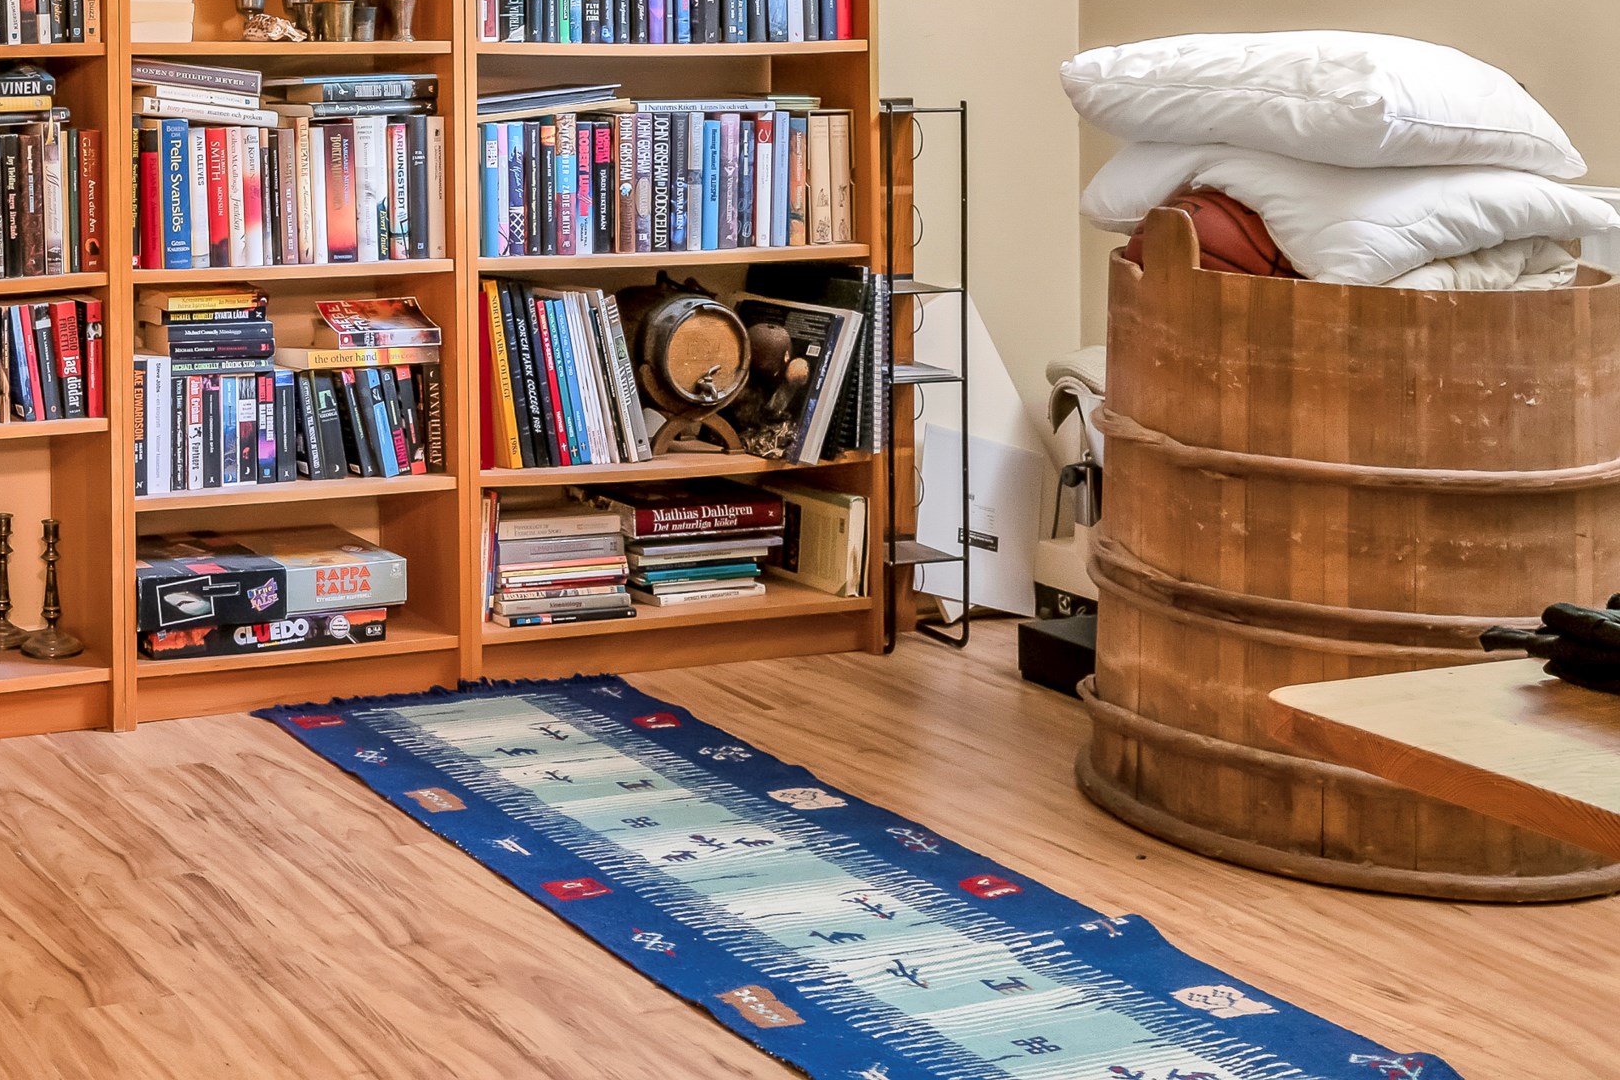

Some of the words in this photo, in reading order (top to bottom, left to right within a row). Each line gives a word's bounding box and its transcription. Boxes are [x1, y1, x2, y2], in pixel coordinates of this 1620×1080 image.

[52, 2, 62, 23] joker
[137, 66, 168, 77] SONEN
[176, 71, 212, 82] PHILIPP
[214, 76, 245, 86] MEYER
[620, 117, 632, 141] JOHN
[654, 115, 665, 140] JOHN
[170, 140, 181, 170] Pelle
[211, 140, 222, 180] SMITH
[620, 143, 633, 181] GRISHAM
[654, 142, 665, 181] GRISHAM
[397, 151, 406, 209] JUNGSTEDT
[171, 173, 184, 232] Svanslös
[654, 186, 666, 248] DÖDSCELLEN
[380, 233, 388, 255] Taube
[491, 295, 502, 328] NORTH
[60, 318, 69, 352] FALETTI
[68, 316, 77, 350] GIORGIO
[496, 331, 505, 355] PARK
[517, 318, 528, 350] NORTH
[64, 355, 79, 374] jag
[314, 354, 327, 363] the
[330, 354, 353, 362] other
[355, 351, 377, 361] hand
[522, 353, 532, 376] PARK
[67, 376, 82, 407] dödar
[134, 370, 146, 387] ÅKE
[500, 358, 511, 400] COLLEGE
[527, 379, 540, 413] COLLEGE
[134, 388, 144, 440] EDWARDSON
[532, 417, 542, 433] 1984
[652, 508, 699, 523] Mathias
[701, 504, 753, 521] Dahlgren
[652, 522, 669, 533] Det
[670, 519, 712, 533] naturliga
[714, 517, 738, 529] köket
[316, 566, 371, 582] RAPPA
[316, 579, 371, 596] KALJA
[233, 618, 309, 646] CLUEDO
